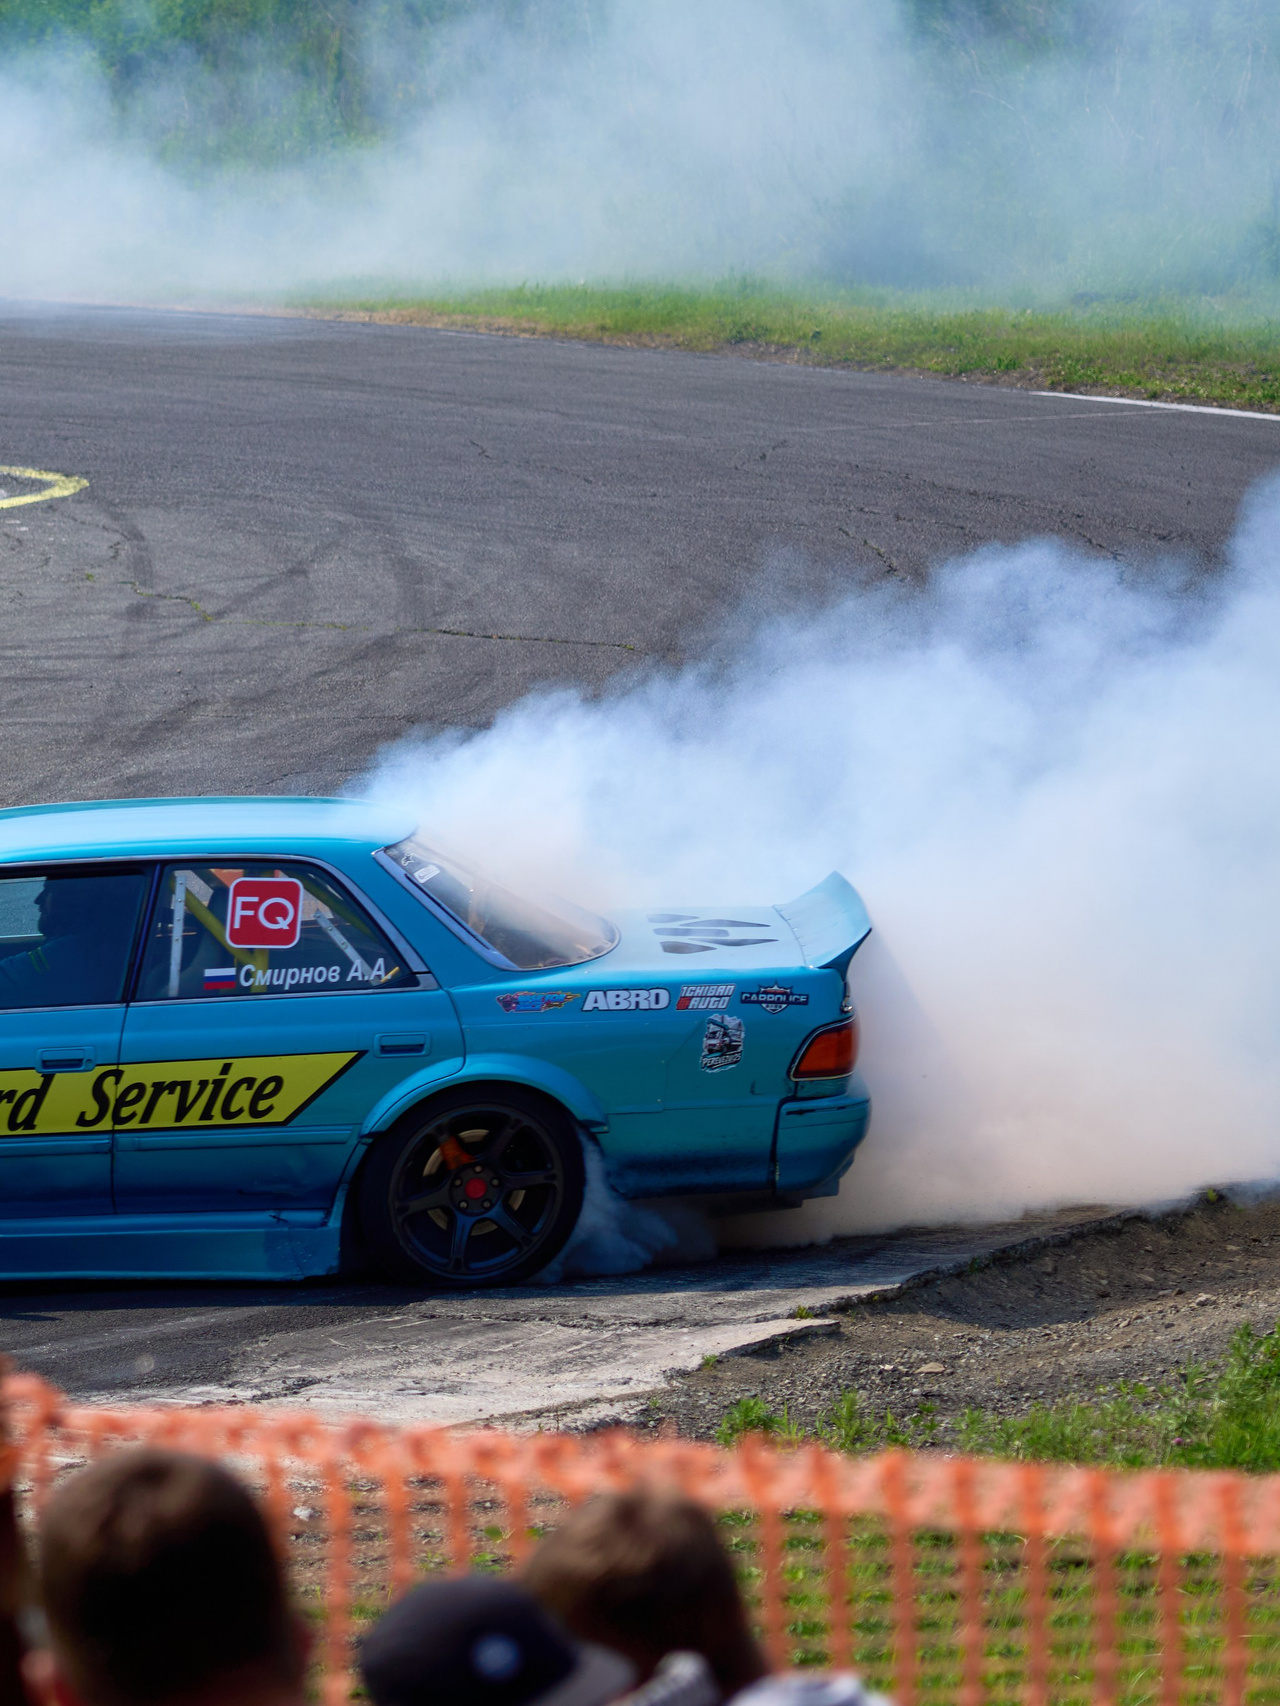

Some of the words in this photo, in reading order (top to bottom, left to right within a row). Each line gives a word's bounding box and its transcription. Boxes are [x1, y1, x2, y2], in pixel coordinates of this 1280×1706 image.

[233, 896, 295, 930] FQ
[239, 964, 341, 991] Смирнов
[582, 989, 669, 1010] ABRO
[681, 985, 735, 997] ICHIBAN
[687, 996, 730, 1010] AUTO
[75, 1063, 285, 1129] Service
